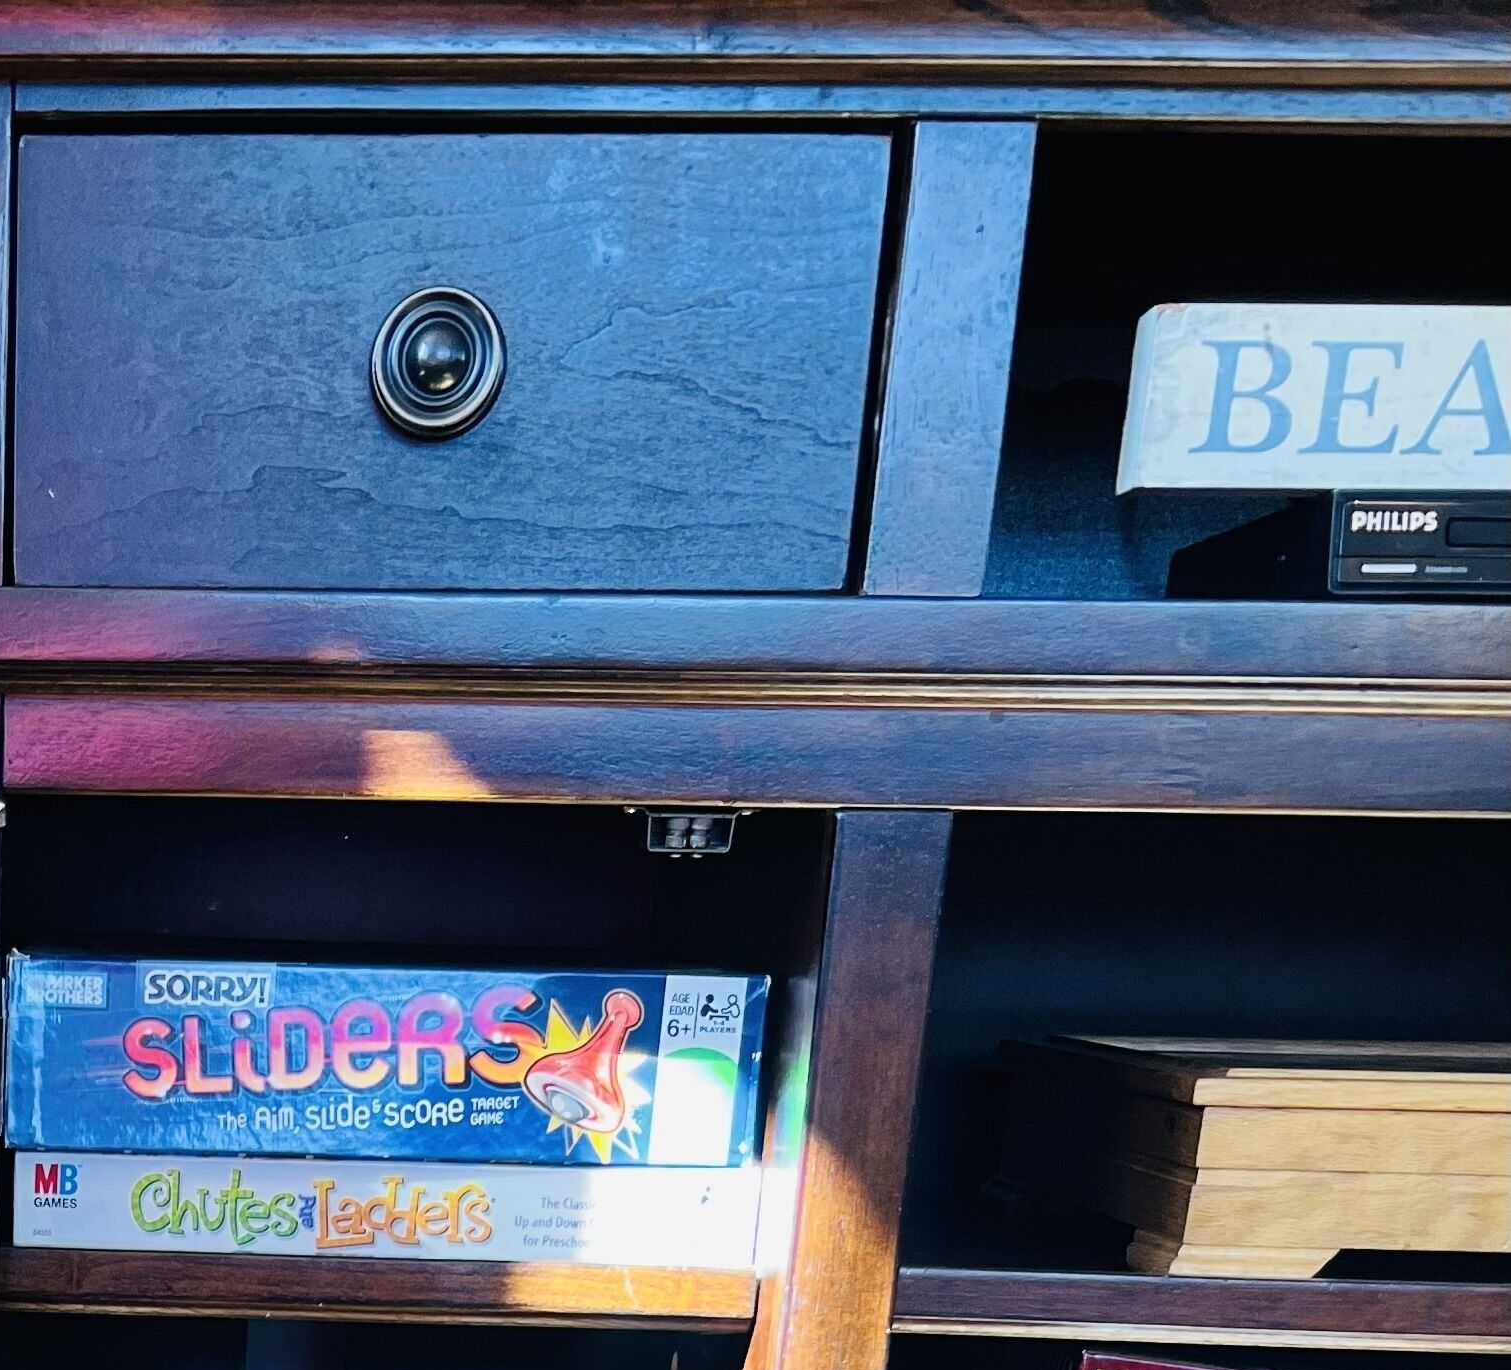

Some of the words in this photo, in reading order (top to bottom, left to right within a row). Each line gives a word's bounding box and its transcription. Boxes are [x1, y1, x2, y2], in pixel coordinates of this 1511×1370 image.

[1187, 338, 1511, 457] BEA
[1351, 510, 1439, 532] PHILIPS
[147, 973, 268, 1005] SORRY!
[671, 993, 691, 1003] AGE
[669, 1005, 694, 1016] EDAD
[667, 1018, 691, 1037] 6+
[470, 1096, 520, 1111] TARGET
[470, 1111, 504, 1126] GAME
[34, 1163, 78, 1195] MB
[33, 1196, 78, 1209] GAMES
[130, 1168, 300, 1246] Chutes
[313, 1175, 494, 1249] Ladders
[541, 1197, 560, 1209] The
[515, 1215, 529, 1230] Up
[532, 1216, 553, 1228] and
[523, 1234, 539, 1246] for
[543, 1235, 593, 1248] Preschoo
